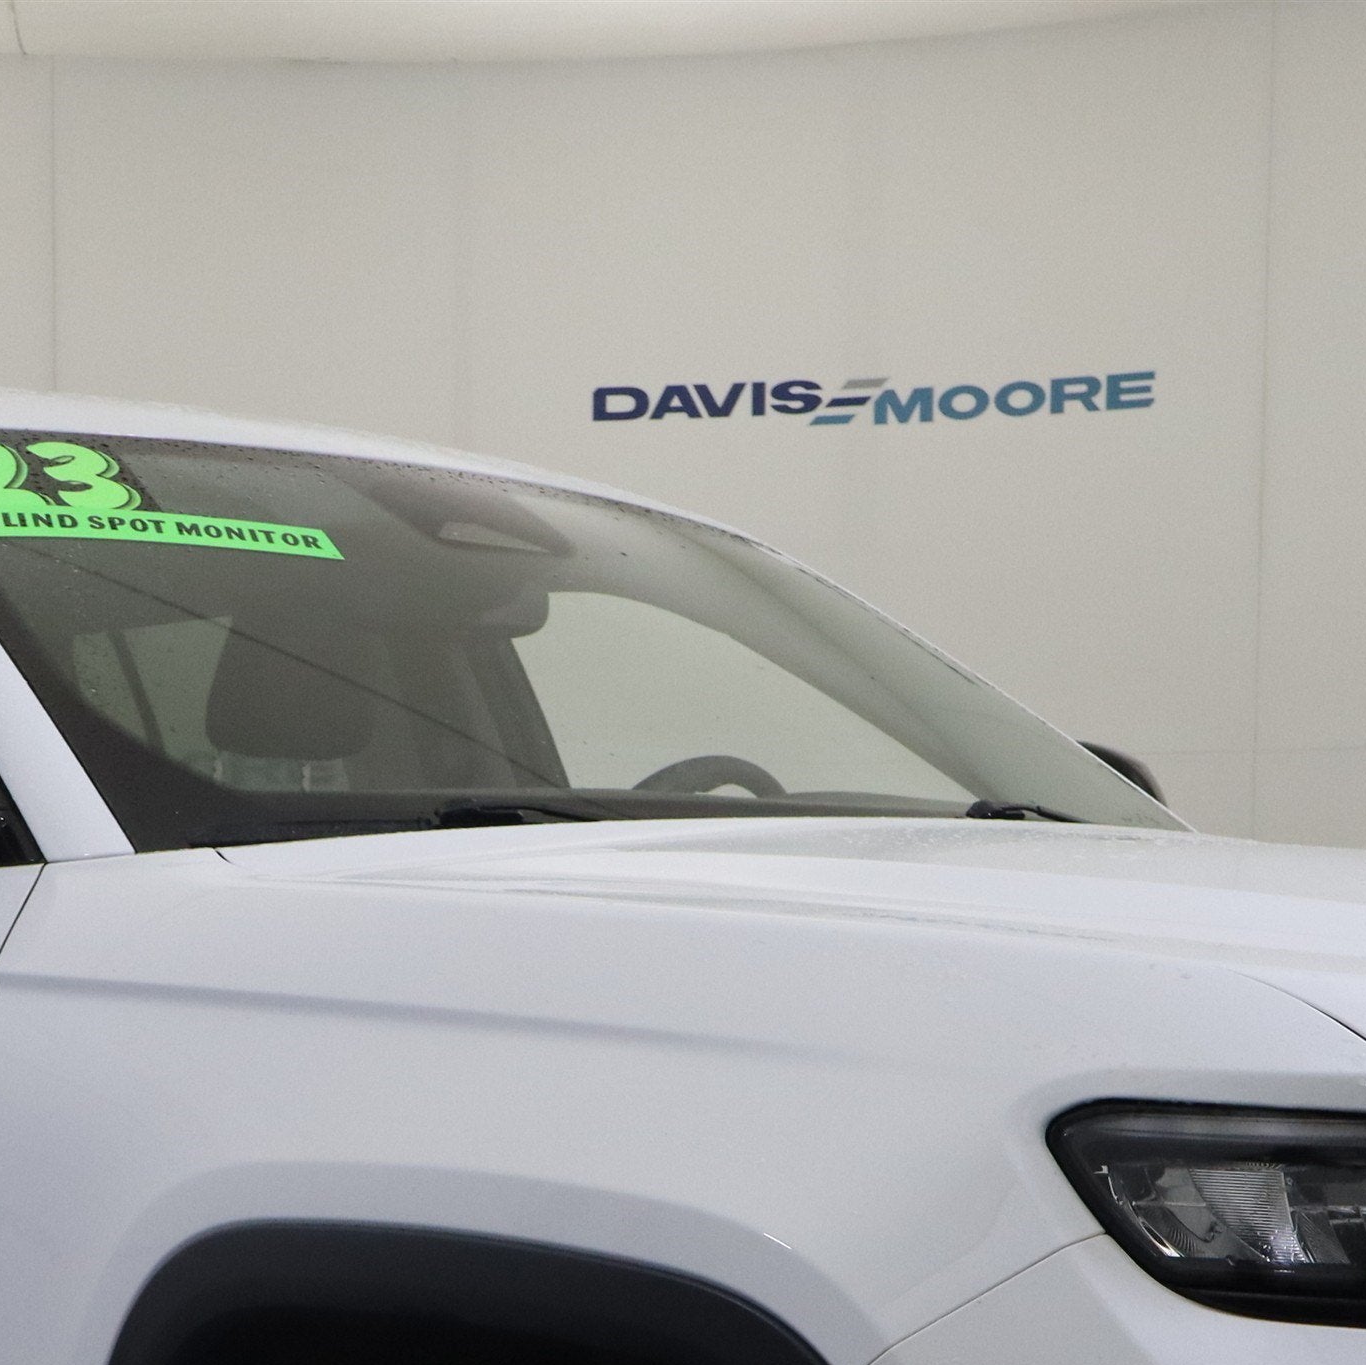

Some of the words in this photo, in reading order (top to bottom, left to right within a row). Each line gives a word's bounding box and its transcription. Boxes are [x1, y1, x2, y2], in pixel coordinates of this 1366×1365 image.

[592, 380, 823, 422] DAVIS
[874, 371, 1156, 425] MOORE
[87, 515, 166, 534] SPOT
[174, 521, 324, 550] MONITOR
